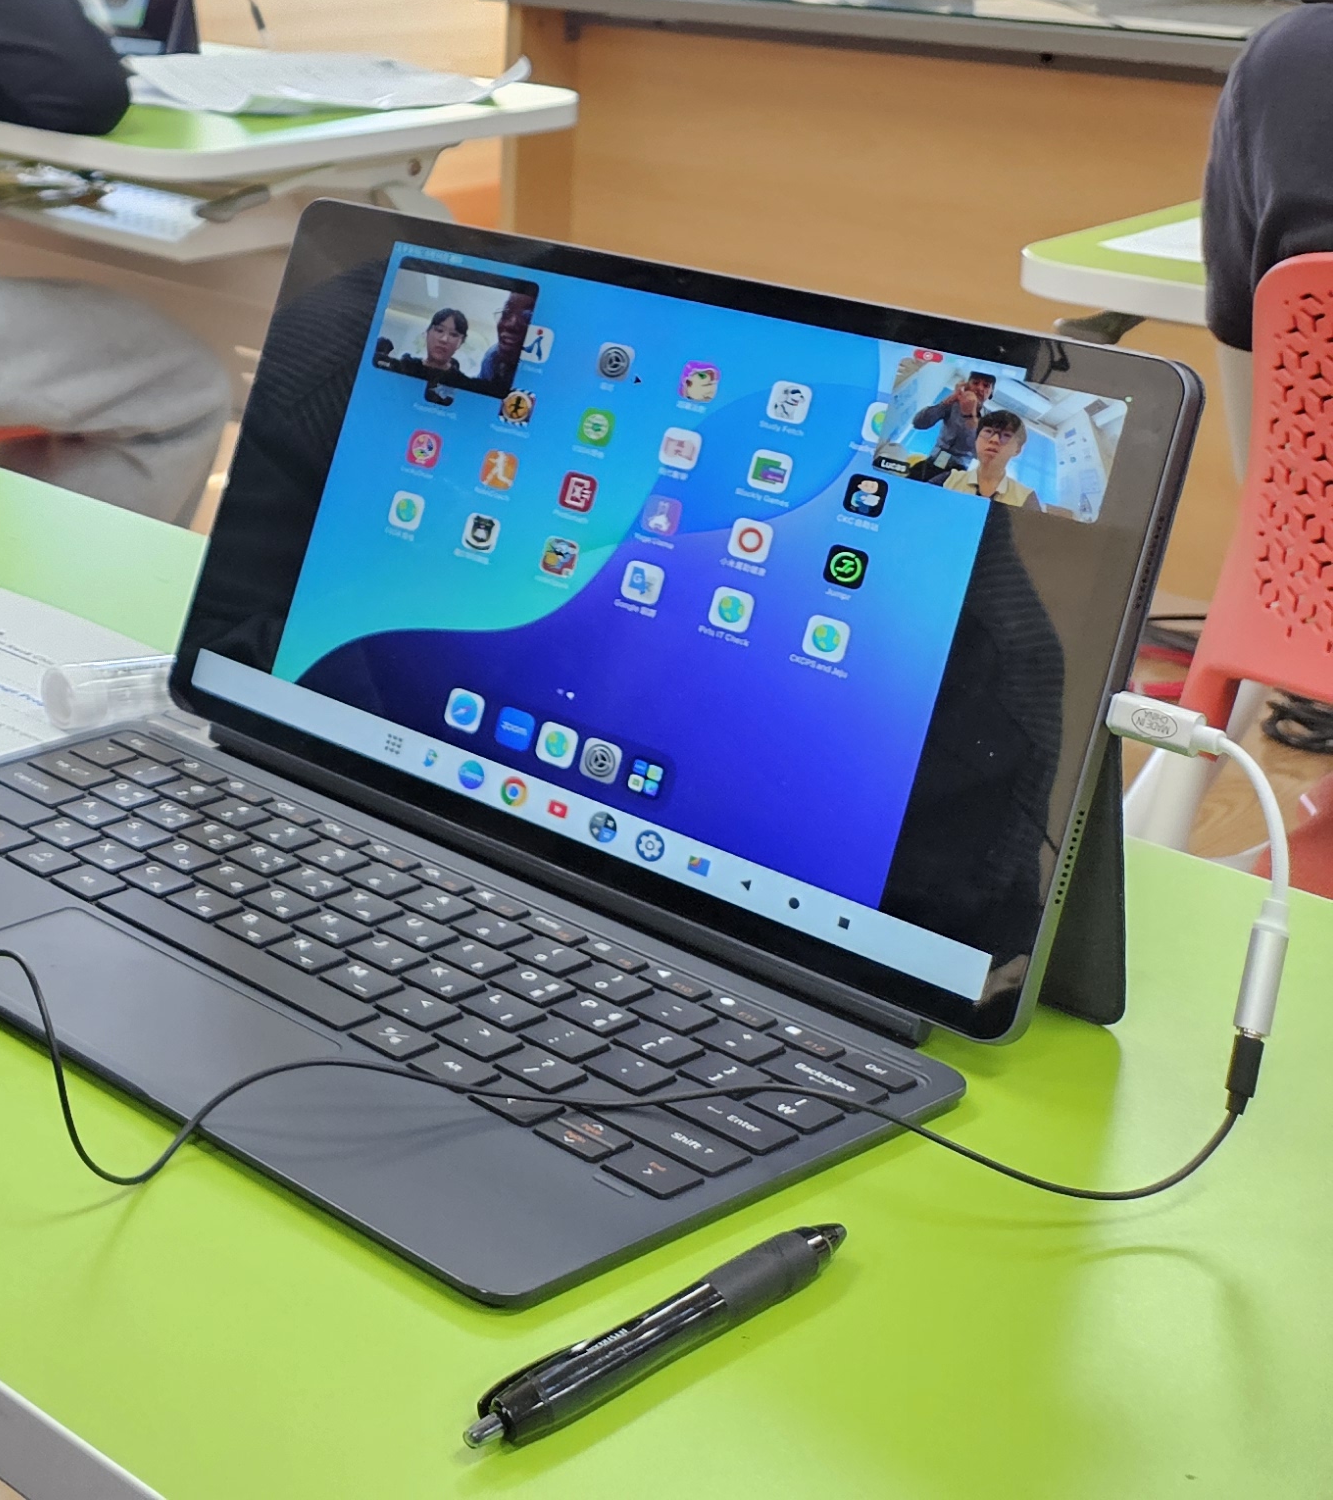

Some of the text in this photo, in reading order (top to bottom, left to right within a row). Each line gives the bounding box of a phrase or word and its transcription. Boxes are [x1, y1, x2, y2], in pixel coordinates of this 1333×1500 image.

[758, 420, 804, 437] Study Fetch
[880, 460, 908, 473] Lucas
[816, 662, 832, 674] and
[501, 720, 528, 737] zoom
[1146, 721, 1171, 736] MADE
[159, 802, 178, 812] W
[347, 965, 369, 976] M
[580, 1000, 599, 1009] P
[864, 1063, 888, 1076] Del
[794, 1062, 856, 1092] Backspace
[727, 1114, 761, 1133] Enter
[670, 1131, 702, 1150] Shift
